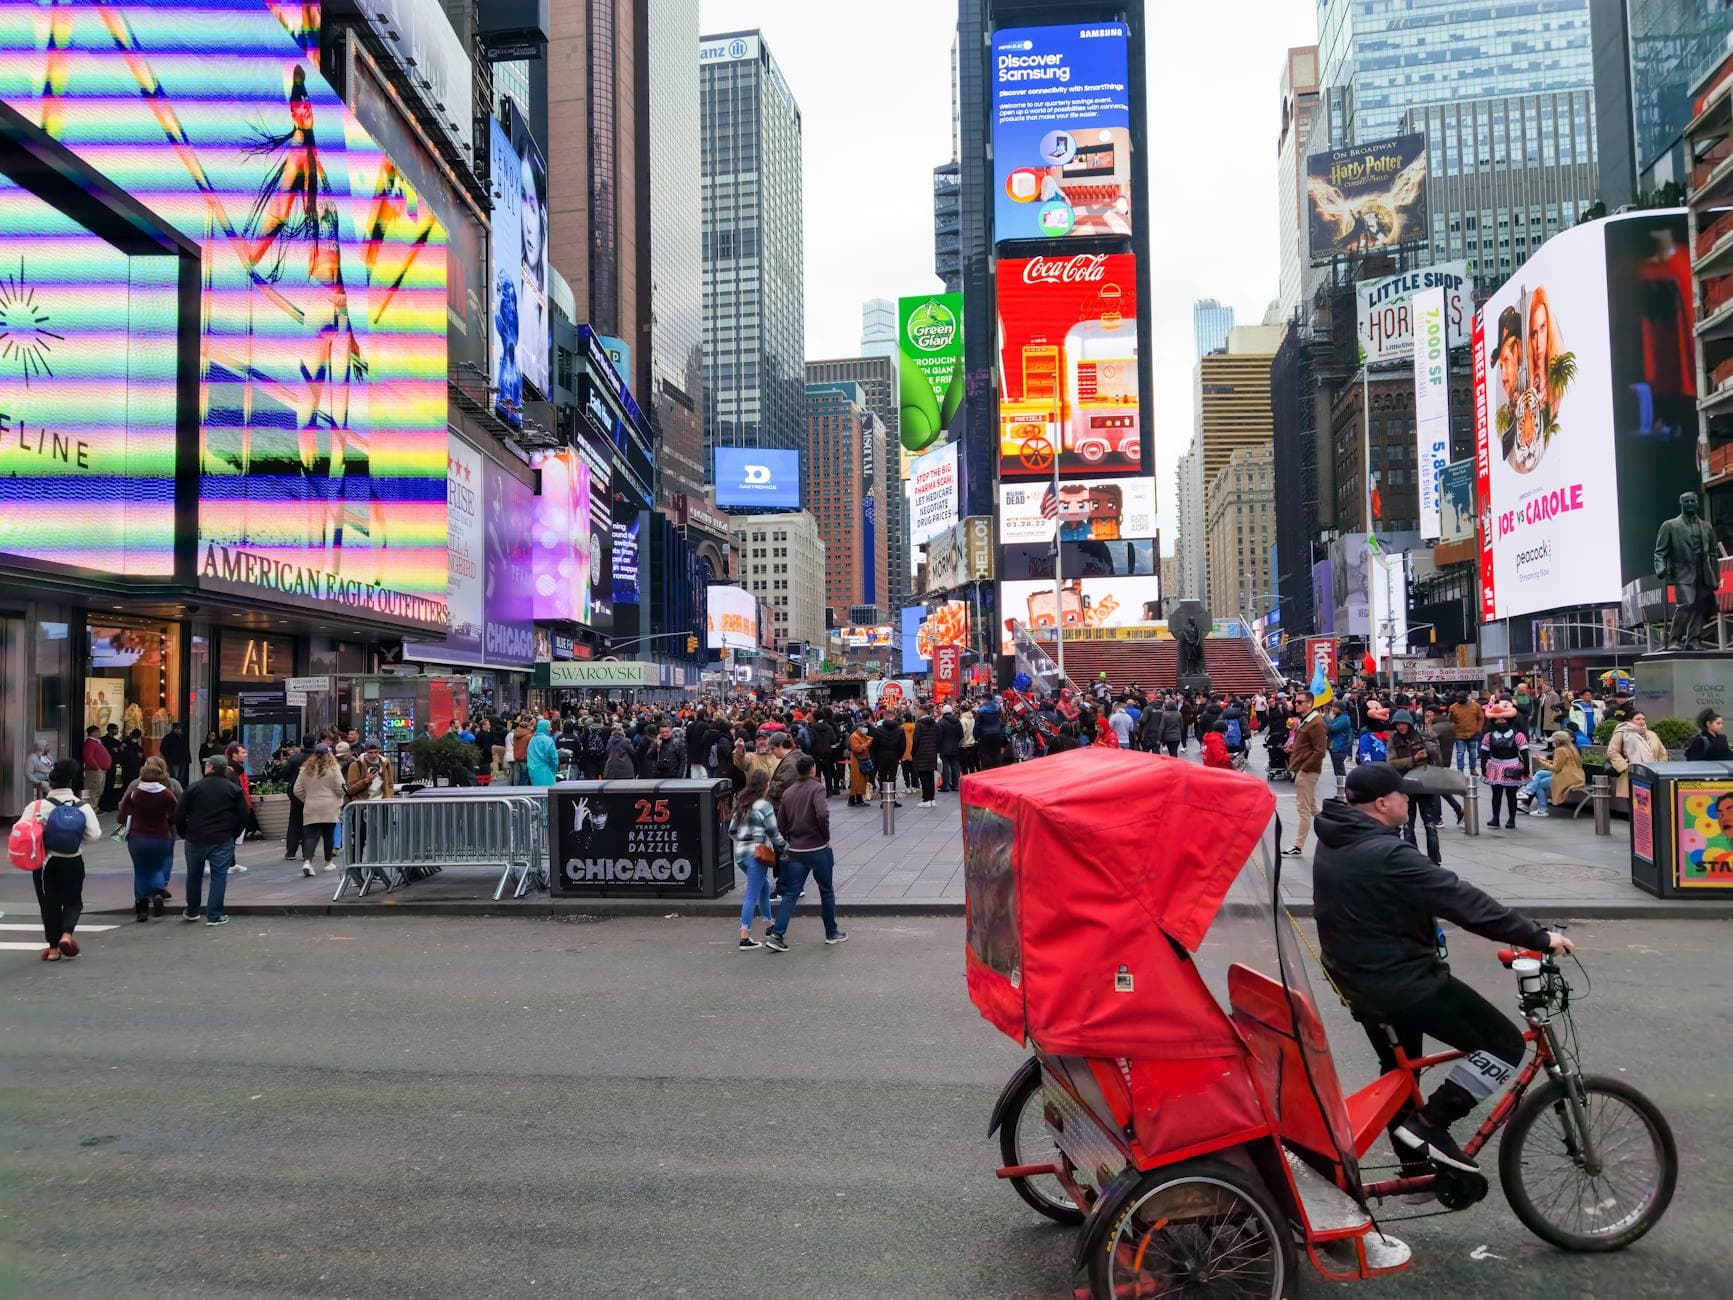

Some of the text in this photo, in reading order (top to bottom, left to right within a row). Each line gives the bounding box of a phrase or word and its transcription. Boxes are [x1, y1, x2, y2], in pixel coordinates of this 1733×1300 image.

[1080, 28, 1122, 38] SAMSUNG
[998, 54, 1063, 69] Discover
[998, 66, 1070, 82] Samsung
[999, 88, 1026, 98] Discover
[1028, 86, 1068, 95] connectivity
[1084, 83, 1124, 92] SmartThings
[1000, 102, 1026, 110] Welcome
[1000, 110, 1016, 118] Open
[1000, 115, 1025, 124] products
[1056, 112, 1070, 120] your
[1333, 140, 1398, 160] ON BROADWAY
[1330, 154, 1403, 188] Harry Potter
[1022, 253, 1109, 284] Coca-Cola
[1369, 272, 1464, 308] LITTLE SHOP
[914, 324, 953, 336] Green
[918, 335, 954, 347] Giant
[1426, 307, 1442, 386] 7,000 SF
[1474, 340, 1486, 382] FREE
[1476, 383, 1489, 478] CHOCOLATE
[916, 462, 952, 484] STOP THE BIG
[448, 477, 475, 516] RISE
[914, 481, 936, 495] PHARMA
[916, 485, 952, 507] LET MEDICARE
[919, 498, 948, 516] NEGOTIATE
[1006, 496, 1026, 506] DEAD
[917, 508, 952, 528] DRUG PRICES
[1498, 510, 1514, 543] JOE
[1526, 484, 1584, 525] CAROLE
[975, 520, 988, 580] HELLO!
[1516, 538, 1548, 574] peacock
[204, 544, 448, 624] AMERICAN EAGLE OUTFITTERS
[1519, 568, 1550, 582] Streaming Now
[486, 622, 533, 658] CHICAGO
[552, 666, 642, 681] SWAROVSKI
[939, 648, 956, 680] tkts
[1693, 684, 1726, 692] GEORGE
[634, 799, 670, 824] 25
[628, 830, 678, 841] RAZZLE
[628, 842, 678, 853] DAZZLE
[566, 858, 692, 880] CHICAGO
[1464, 1050, 1511, 1085] taple
